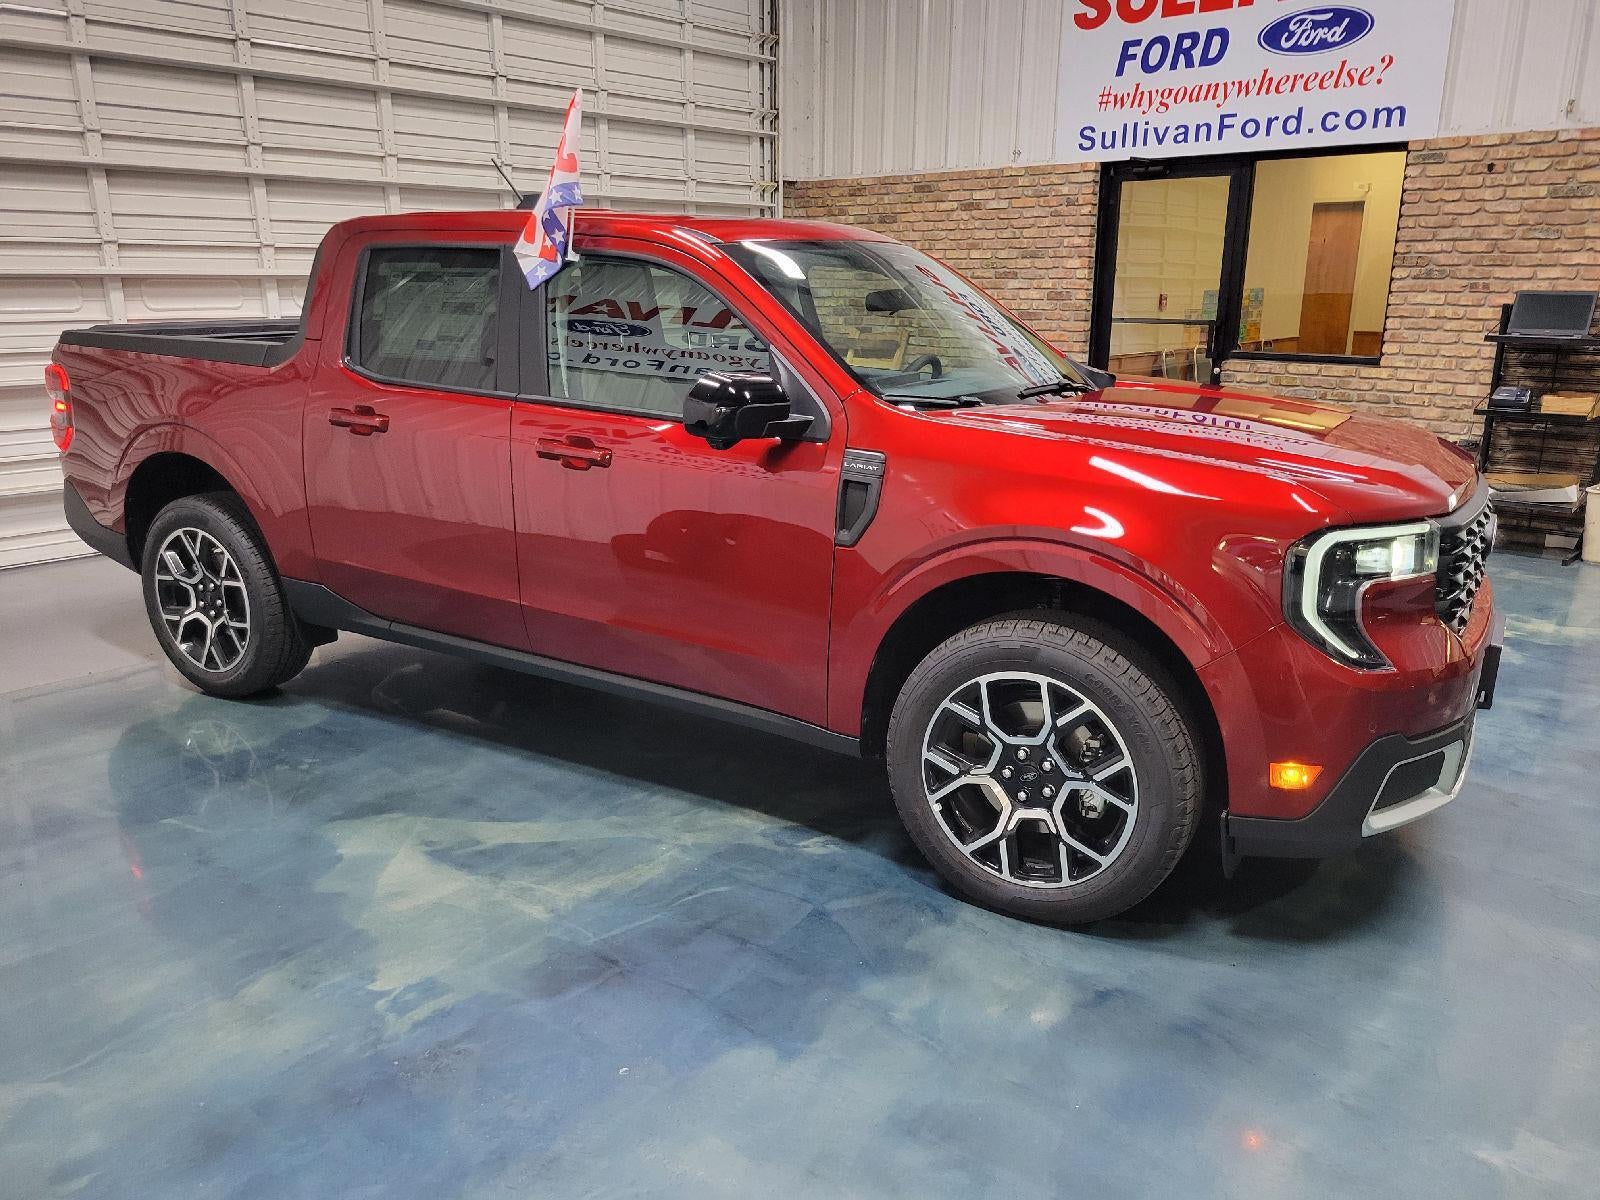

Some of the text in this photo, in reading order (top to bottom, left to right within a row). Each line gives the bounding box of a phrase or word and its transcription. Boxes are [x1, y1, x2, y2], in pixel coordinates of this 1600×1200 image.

[1115, 27, 1230, 77] FORD
[1098, 54, 1394, 114] #whygoanywhereelse?
[1078, 105, 1408, 152] SullivanFord.com
[844, 461, 879, 471] LARIAT
